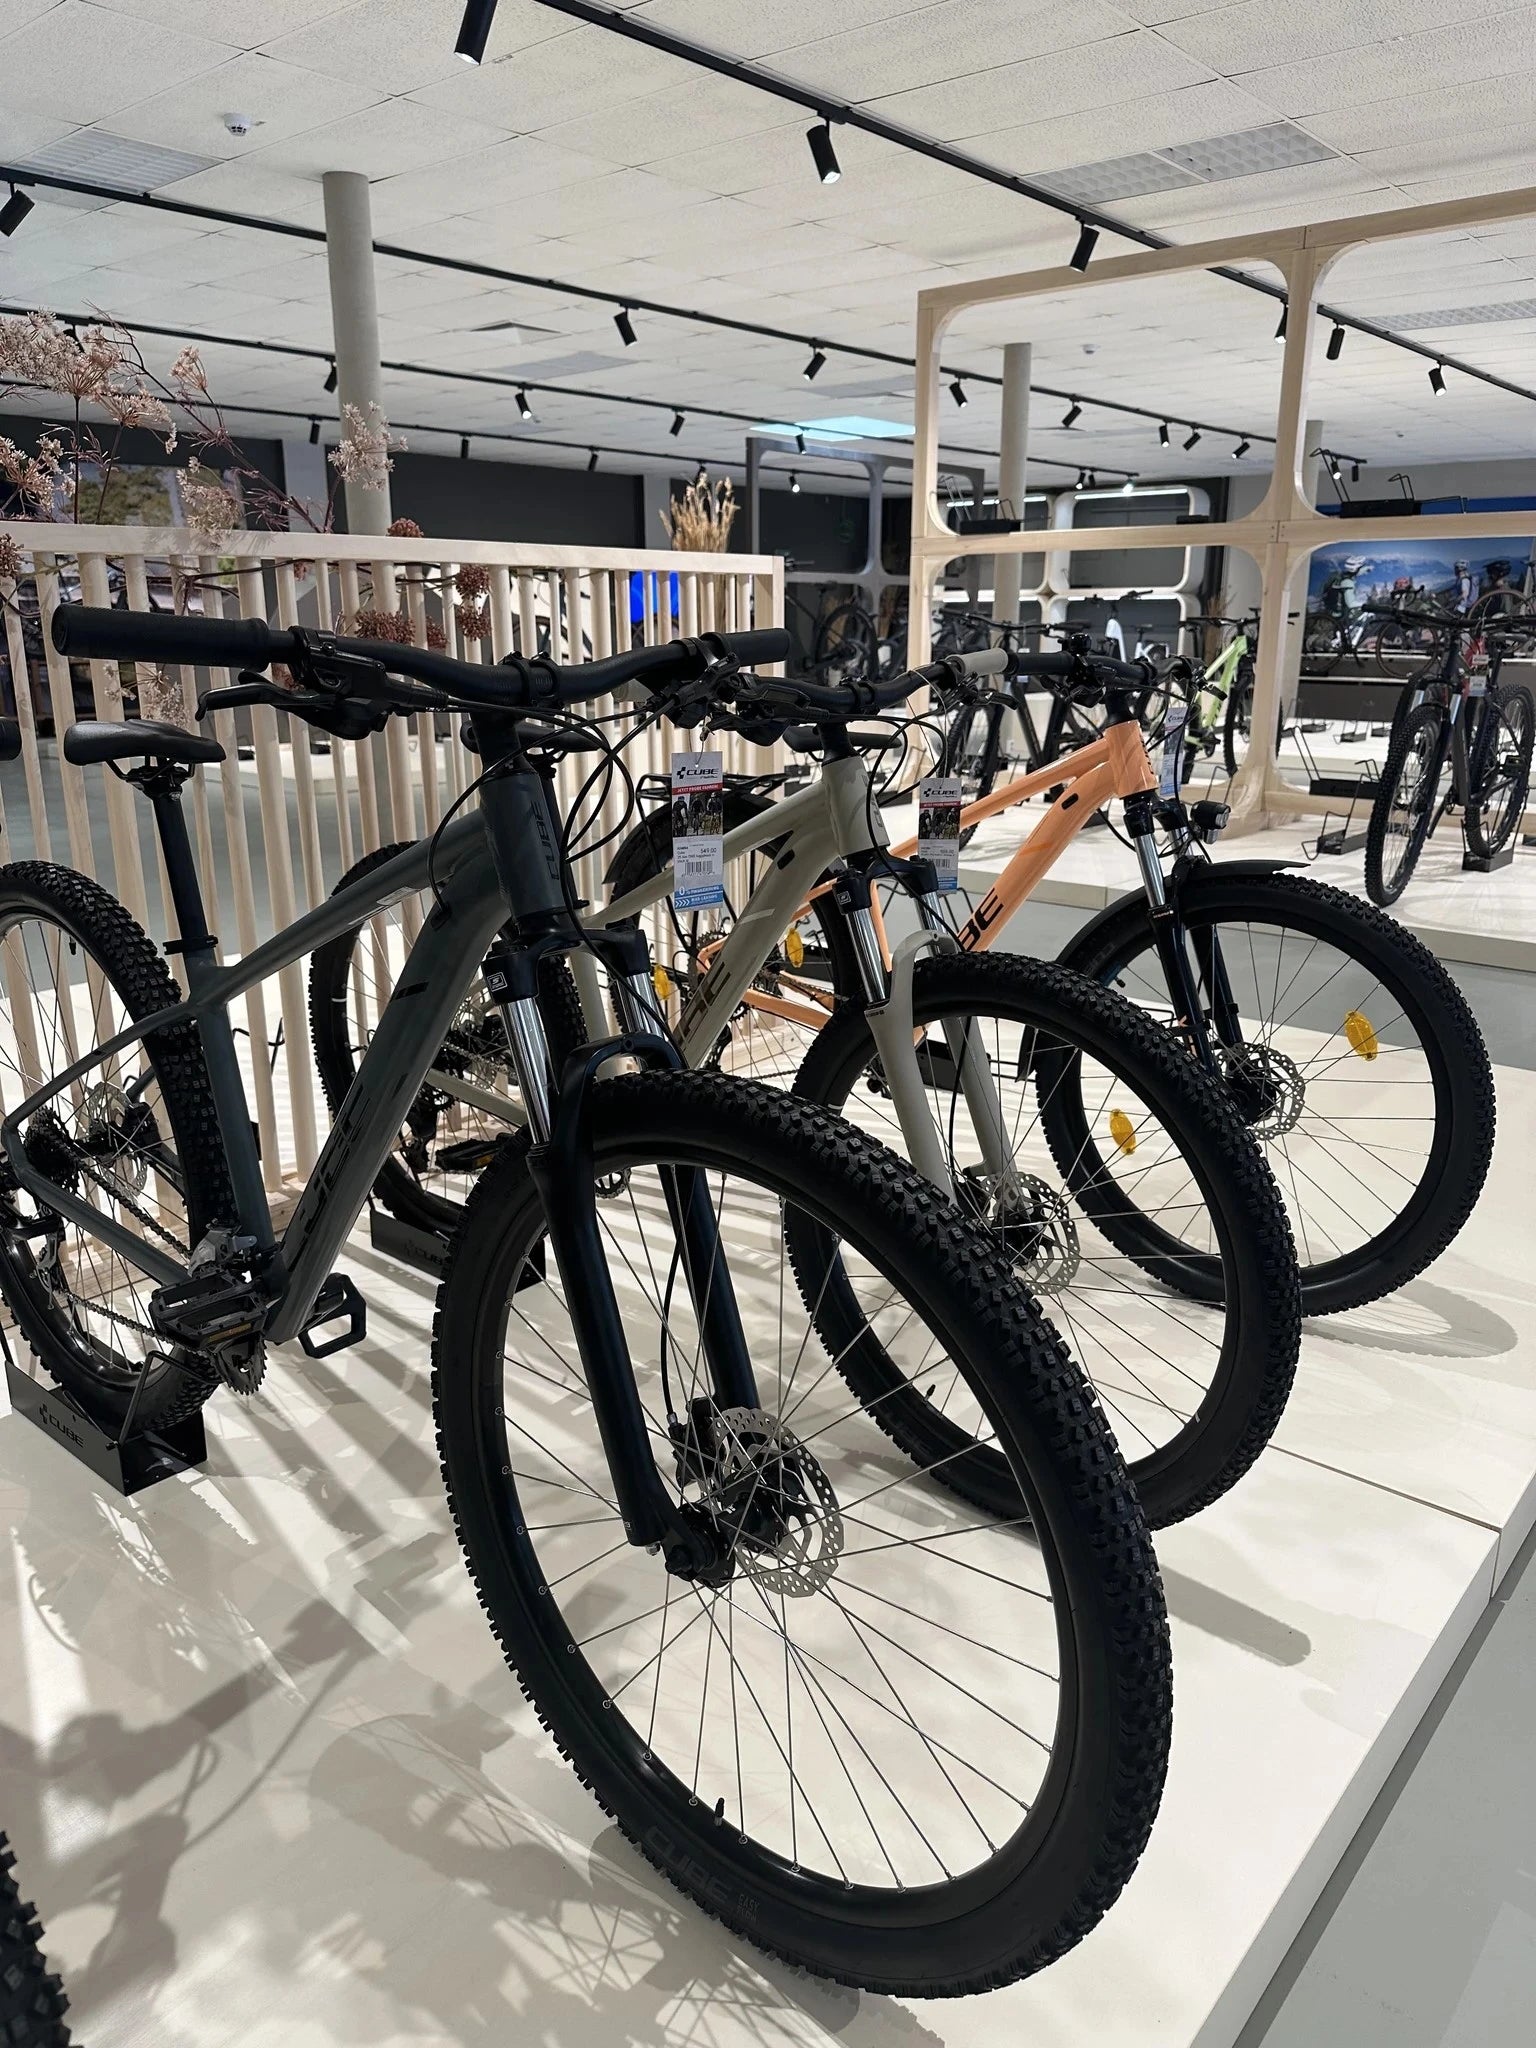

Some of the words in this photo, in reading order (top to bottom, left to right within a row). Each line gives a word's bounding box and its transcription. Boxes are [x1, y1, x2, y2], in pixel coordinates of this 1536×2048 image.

[686, 768, 719, 776] CUBE
[531, 800, 560, 880] CUBE
[957, 888, 1004, 952] BE
[415, 1247, 443, 1266] CUB
[49, 1414, 84, 1448] CUBE
[645, 1826, 729, 1905] CUBE
